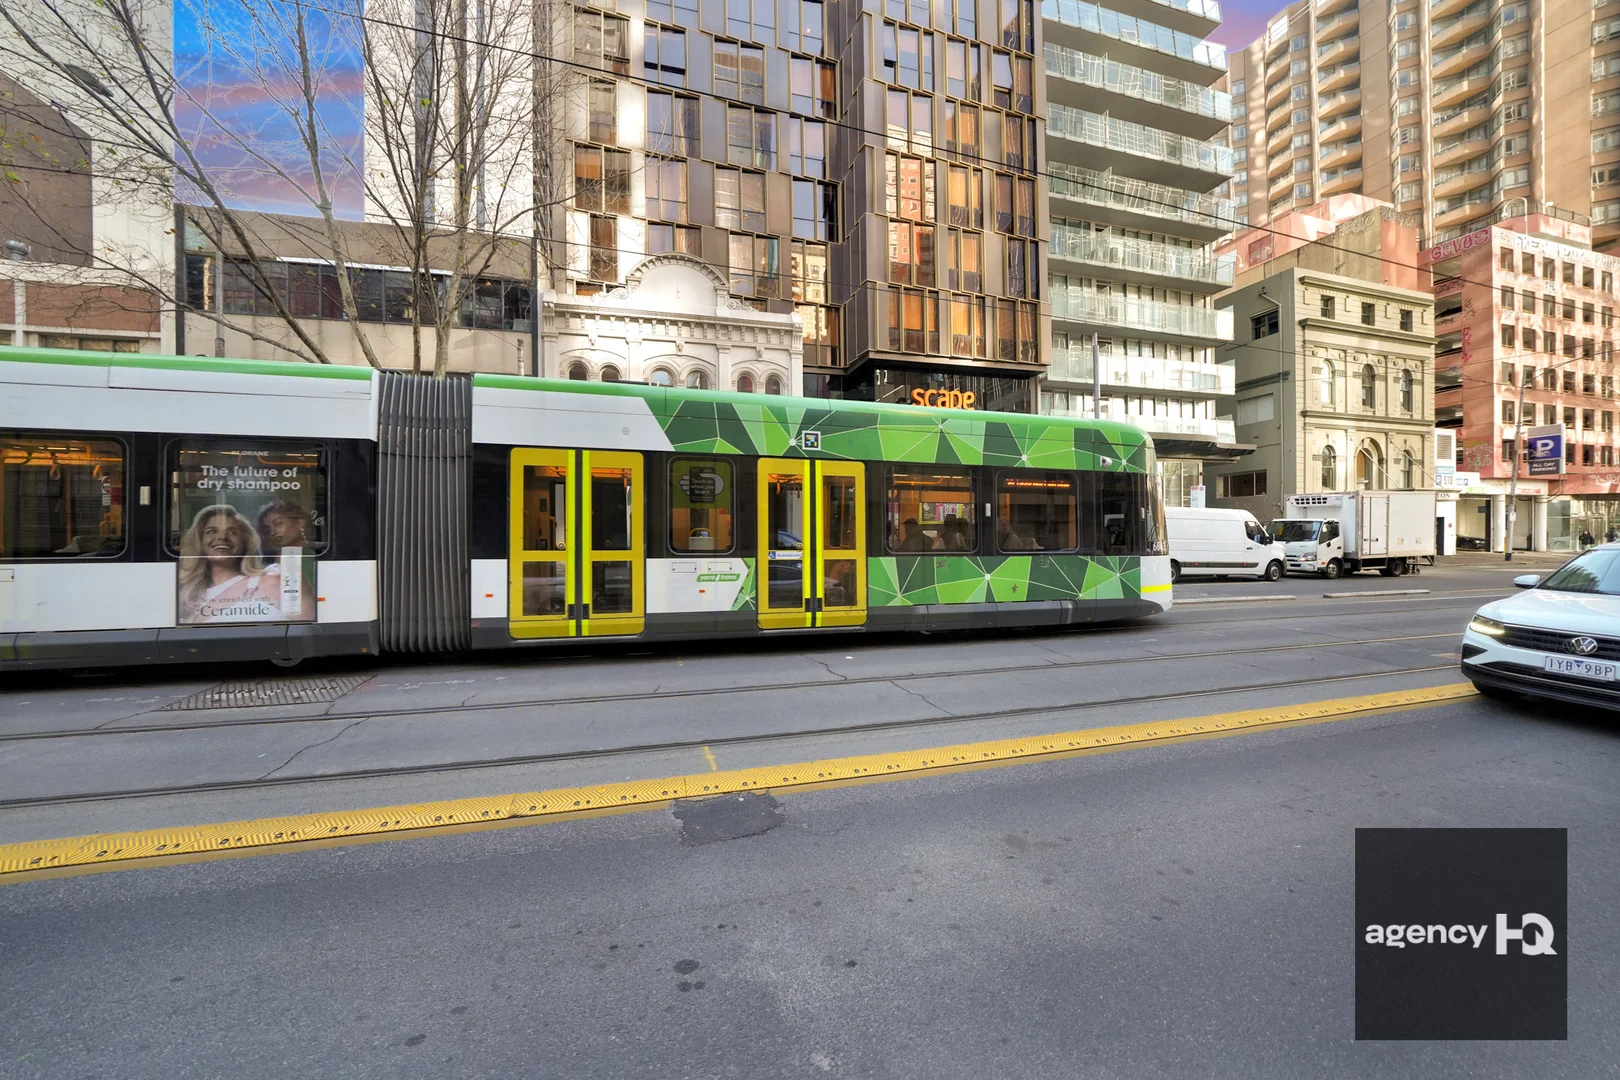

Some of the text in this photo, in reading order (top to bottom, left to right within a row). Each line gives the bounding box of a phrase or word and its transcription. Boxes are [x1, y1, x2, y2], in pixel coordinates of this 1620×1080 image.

[200, 465, 298, 478] The future of
[197, 477, 301, 492] dry shampoo
[200, 603, 270, 617] Ceramide
